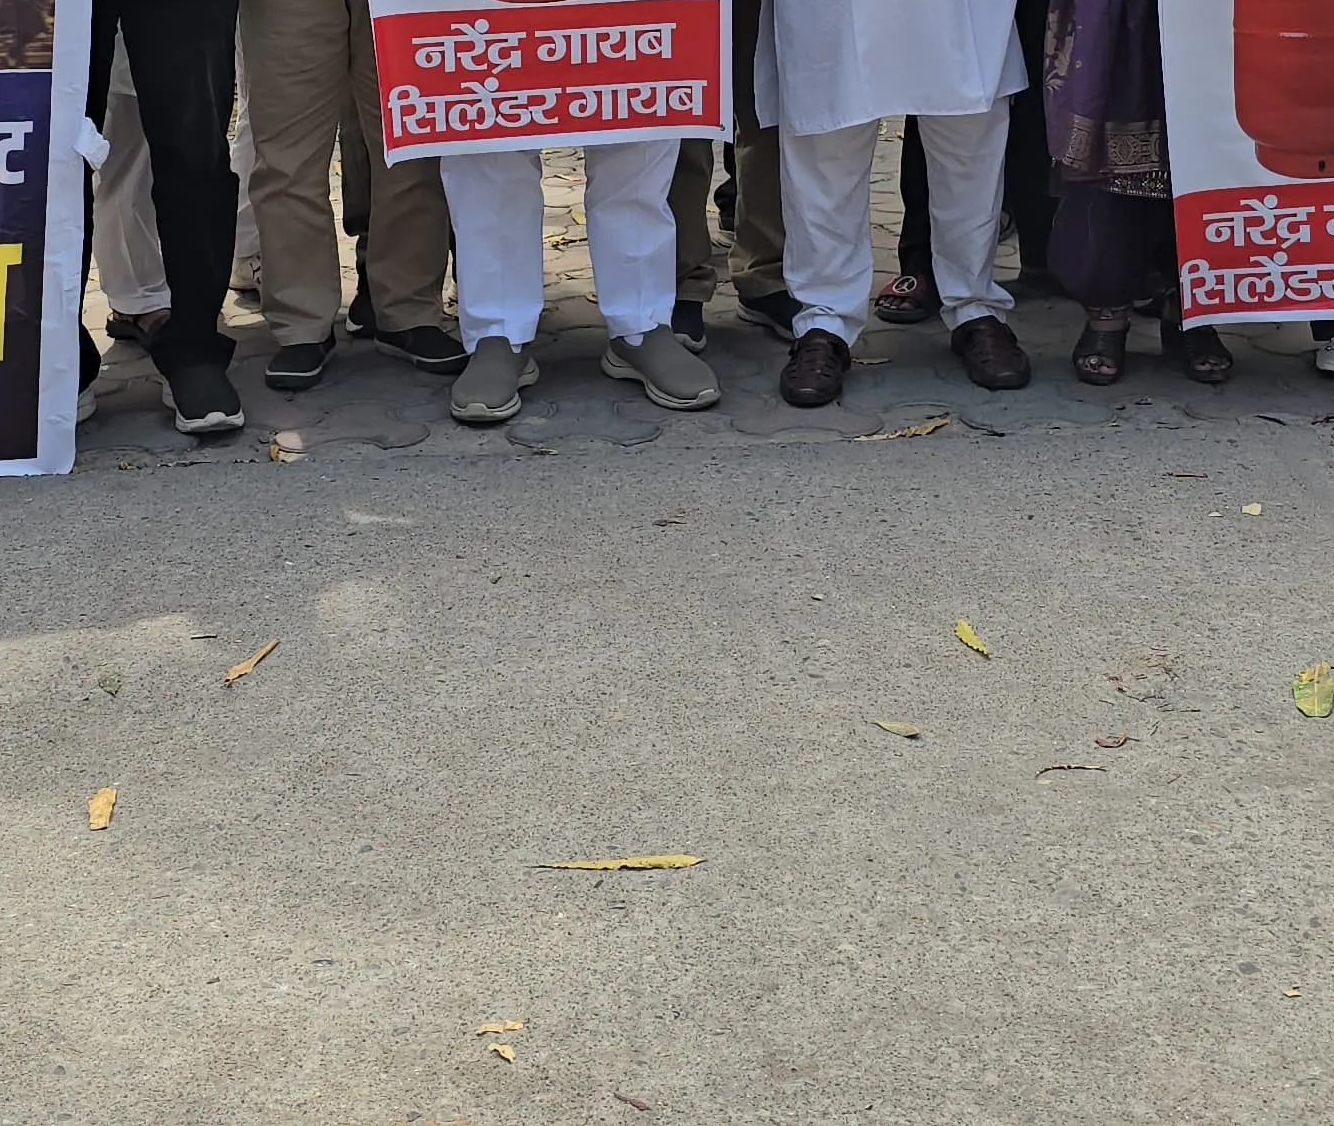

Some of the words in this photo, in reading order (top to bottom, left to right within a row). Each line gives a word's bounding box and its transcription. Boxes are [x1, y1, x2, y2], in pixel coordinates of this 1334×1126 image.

[411, 18, 527, 75] नरेंद्र
[535, 22, 677, 65] गायब
[388, 76, 562, 139] सिलेंडर
[566, 79, 708, 121] गायब
[1202, 194, 1316, 249] नरेंद्र
